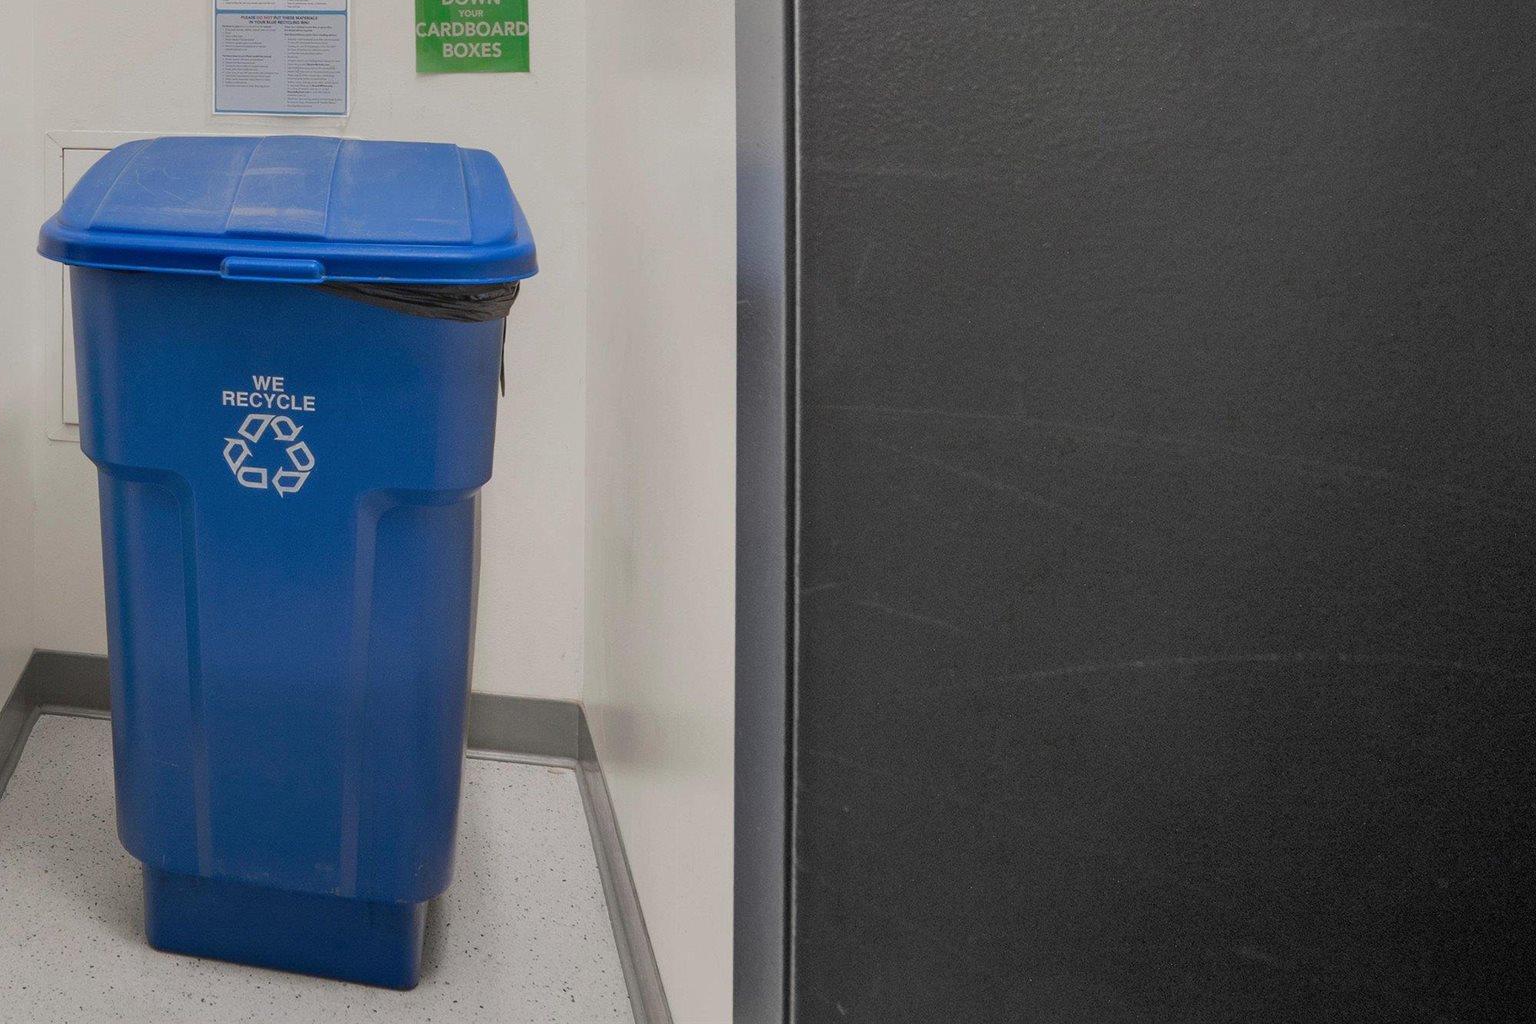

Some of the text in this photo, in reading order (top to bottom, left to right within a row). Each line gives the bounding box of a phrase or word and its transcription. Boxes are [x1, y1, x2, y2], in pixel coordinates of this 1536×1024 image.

[459, 9, 484, 17] YOUR
[416, 22, 529, 37] CARDBOARD
[442, 43, 502, 58] BOXES
[252, 375, 284, 392] WE
[222, 390, 316, 412] RECYCLE
